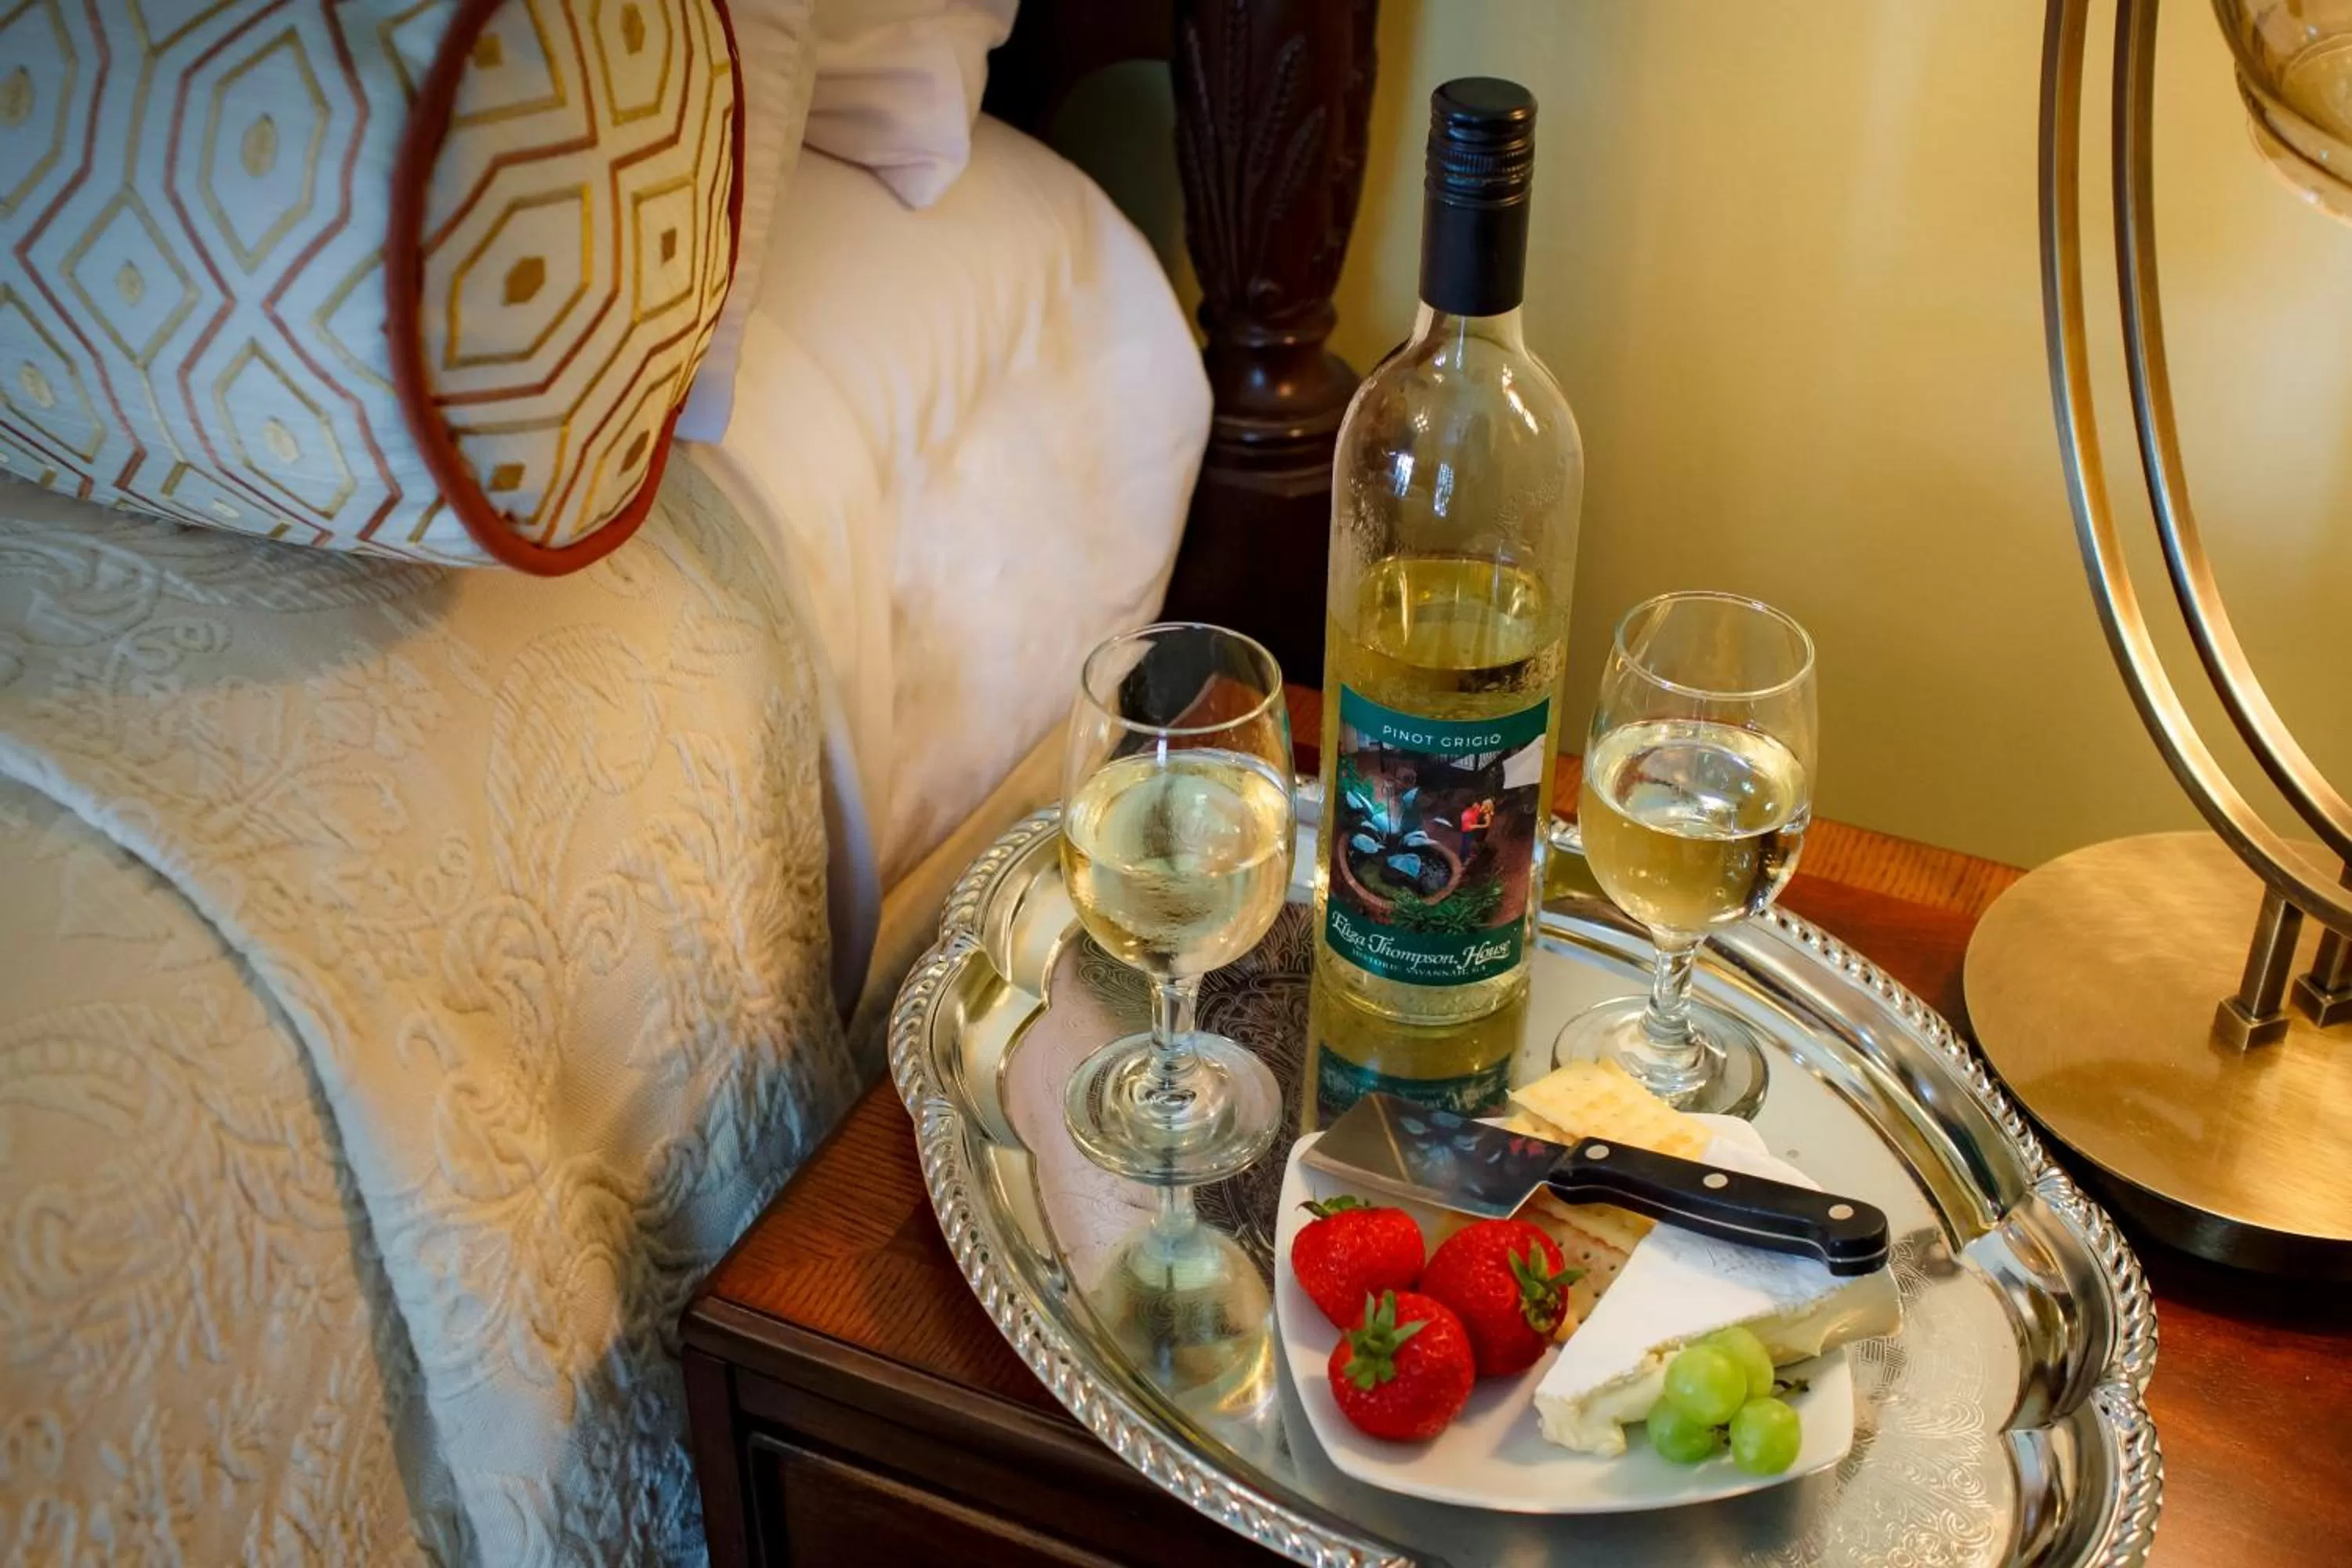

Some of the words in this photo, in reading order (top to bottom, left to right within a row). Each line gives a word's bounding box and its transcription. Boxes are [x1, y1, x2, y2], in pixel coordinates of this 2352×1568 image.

[1383, 724, 1433, 746] PINOT
[1441, 734, 1501, 747] GRIGIO
[1331, 910, 1367, 949] Eliza
[1457, 940, 1511, 969] House
